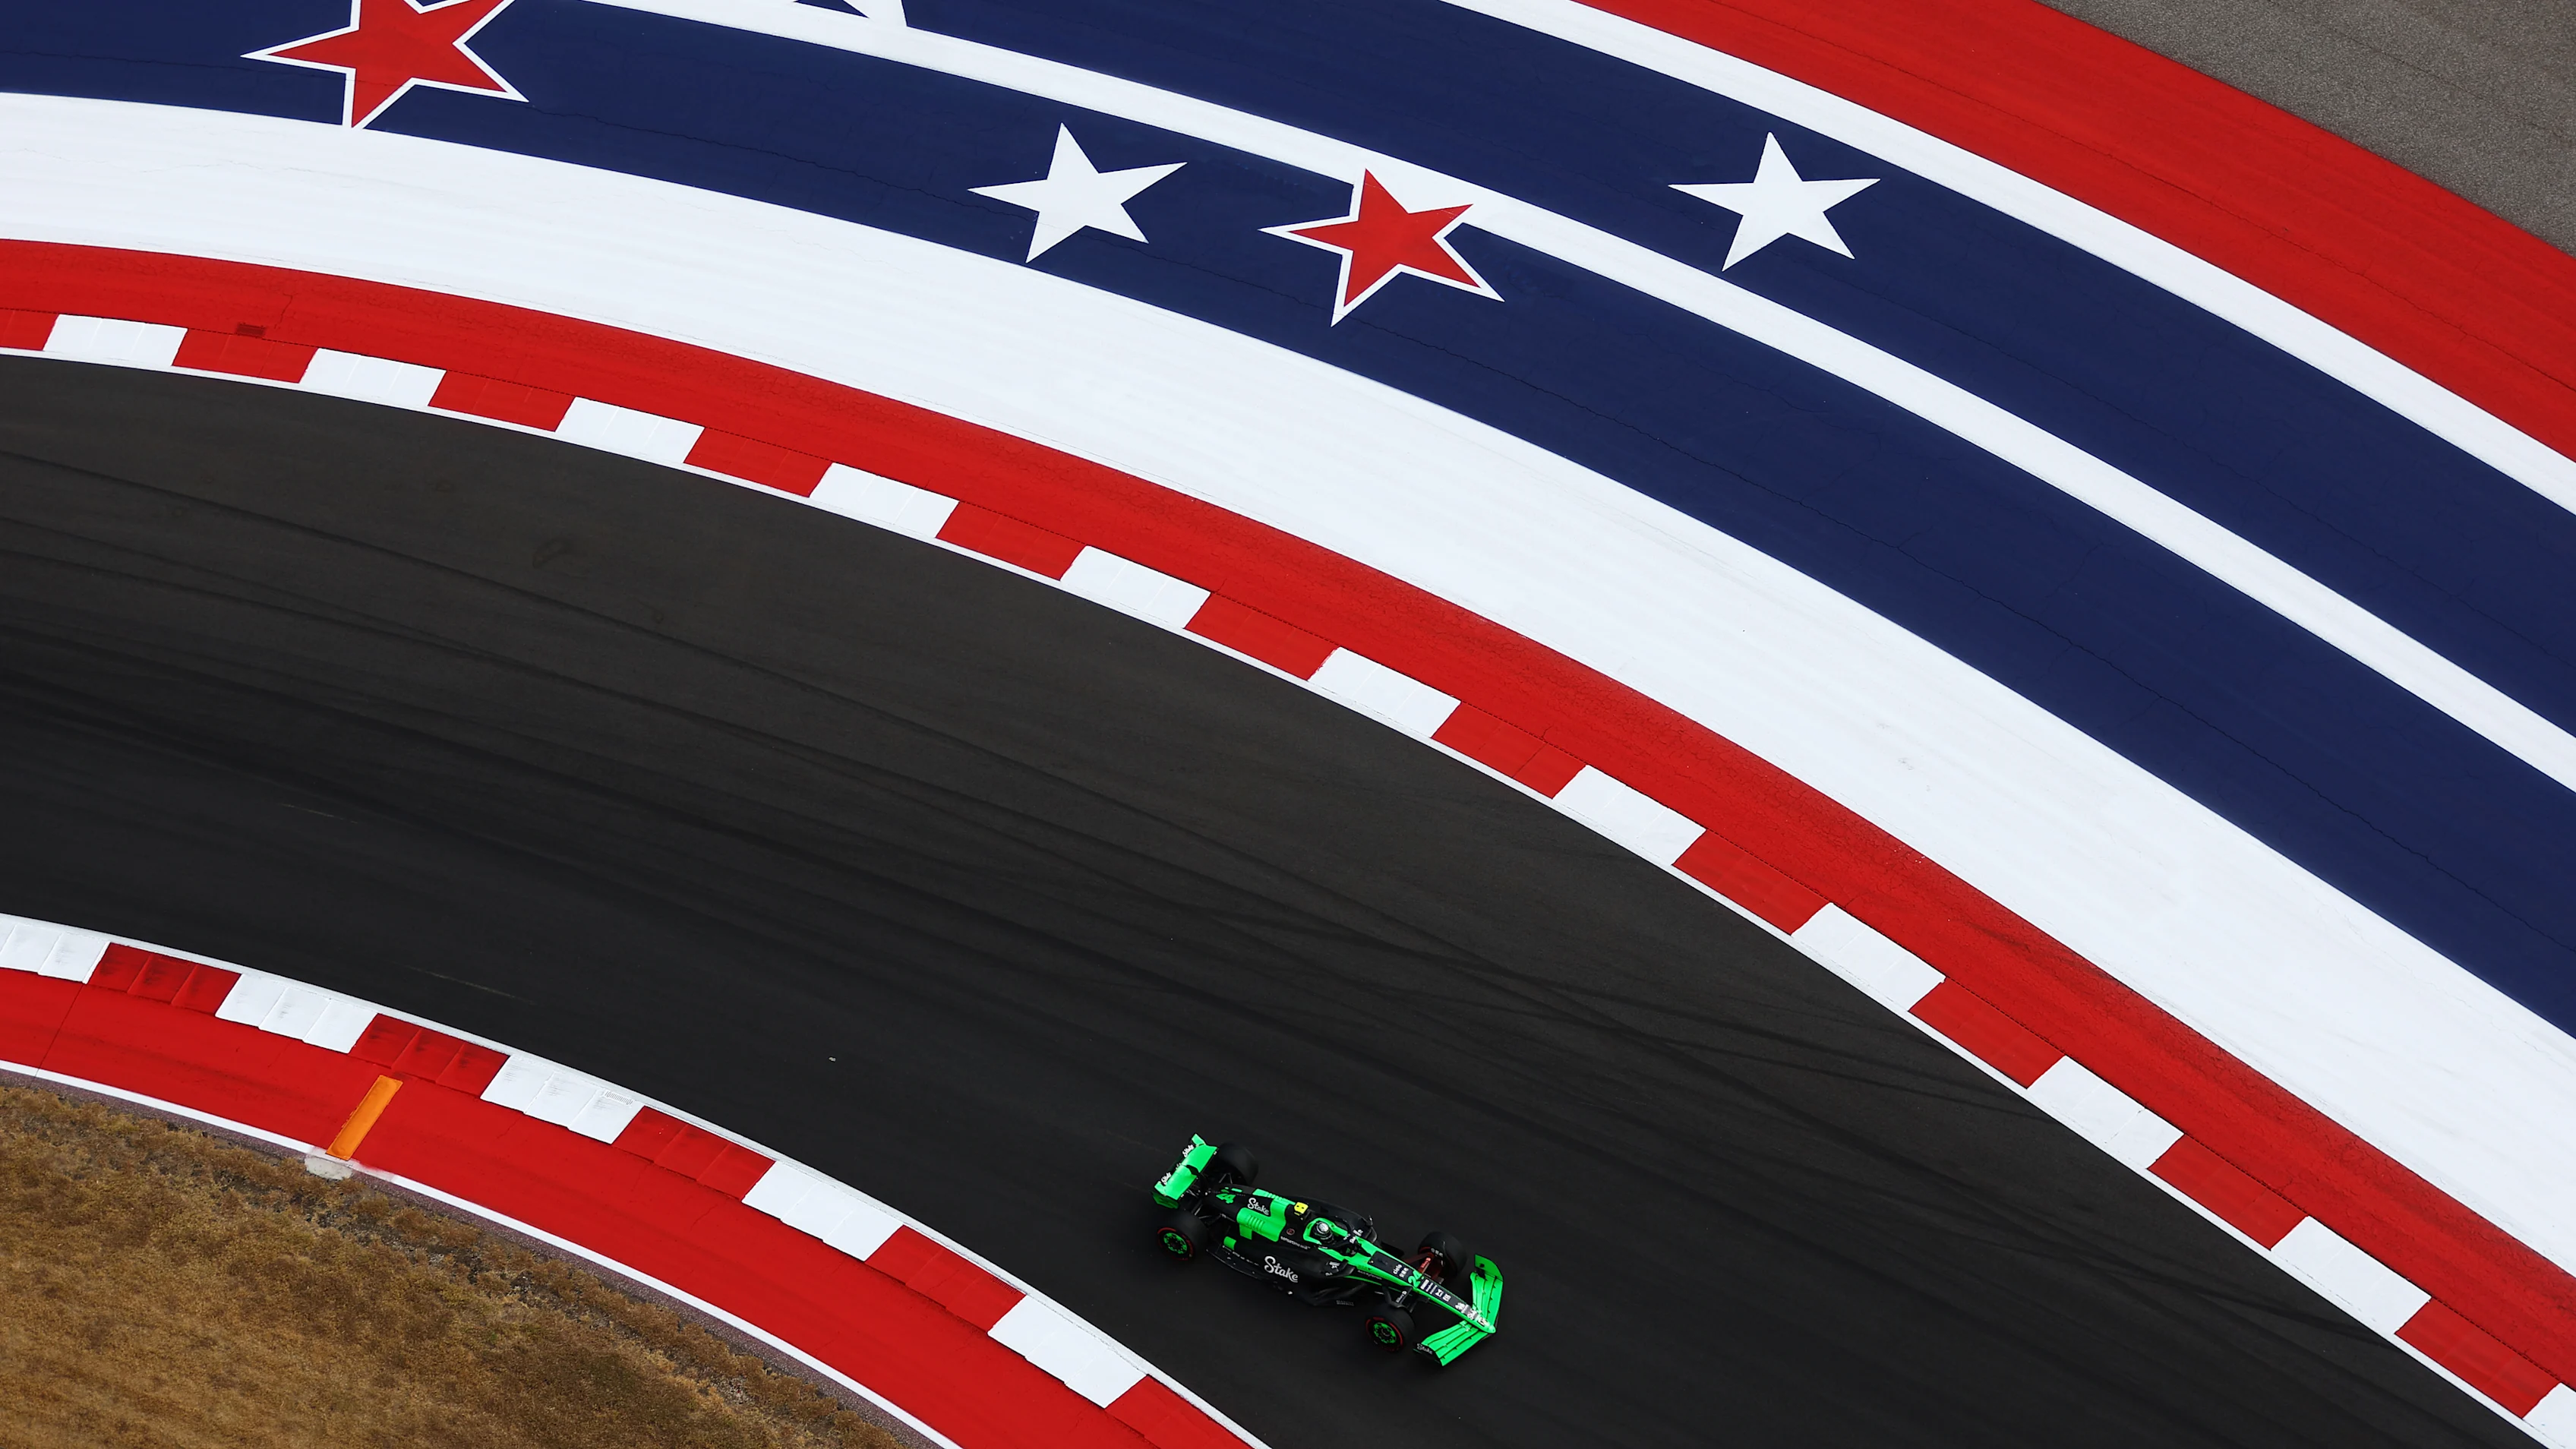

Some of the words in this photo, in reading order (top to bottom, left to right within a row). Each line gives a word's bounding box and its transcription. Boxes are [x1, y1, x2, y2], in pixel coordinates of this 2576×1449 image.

[1247, 1197, 1270, 1216] Stake
[1264, 1255, 1299, 1283] Stake
[1407, 1269, 1423, 1288] 24
